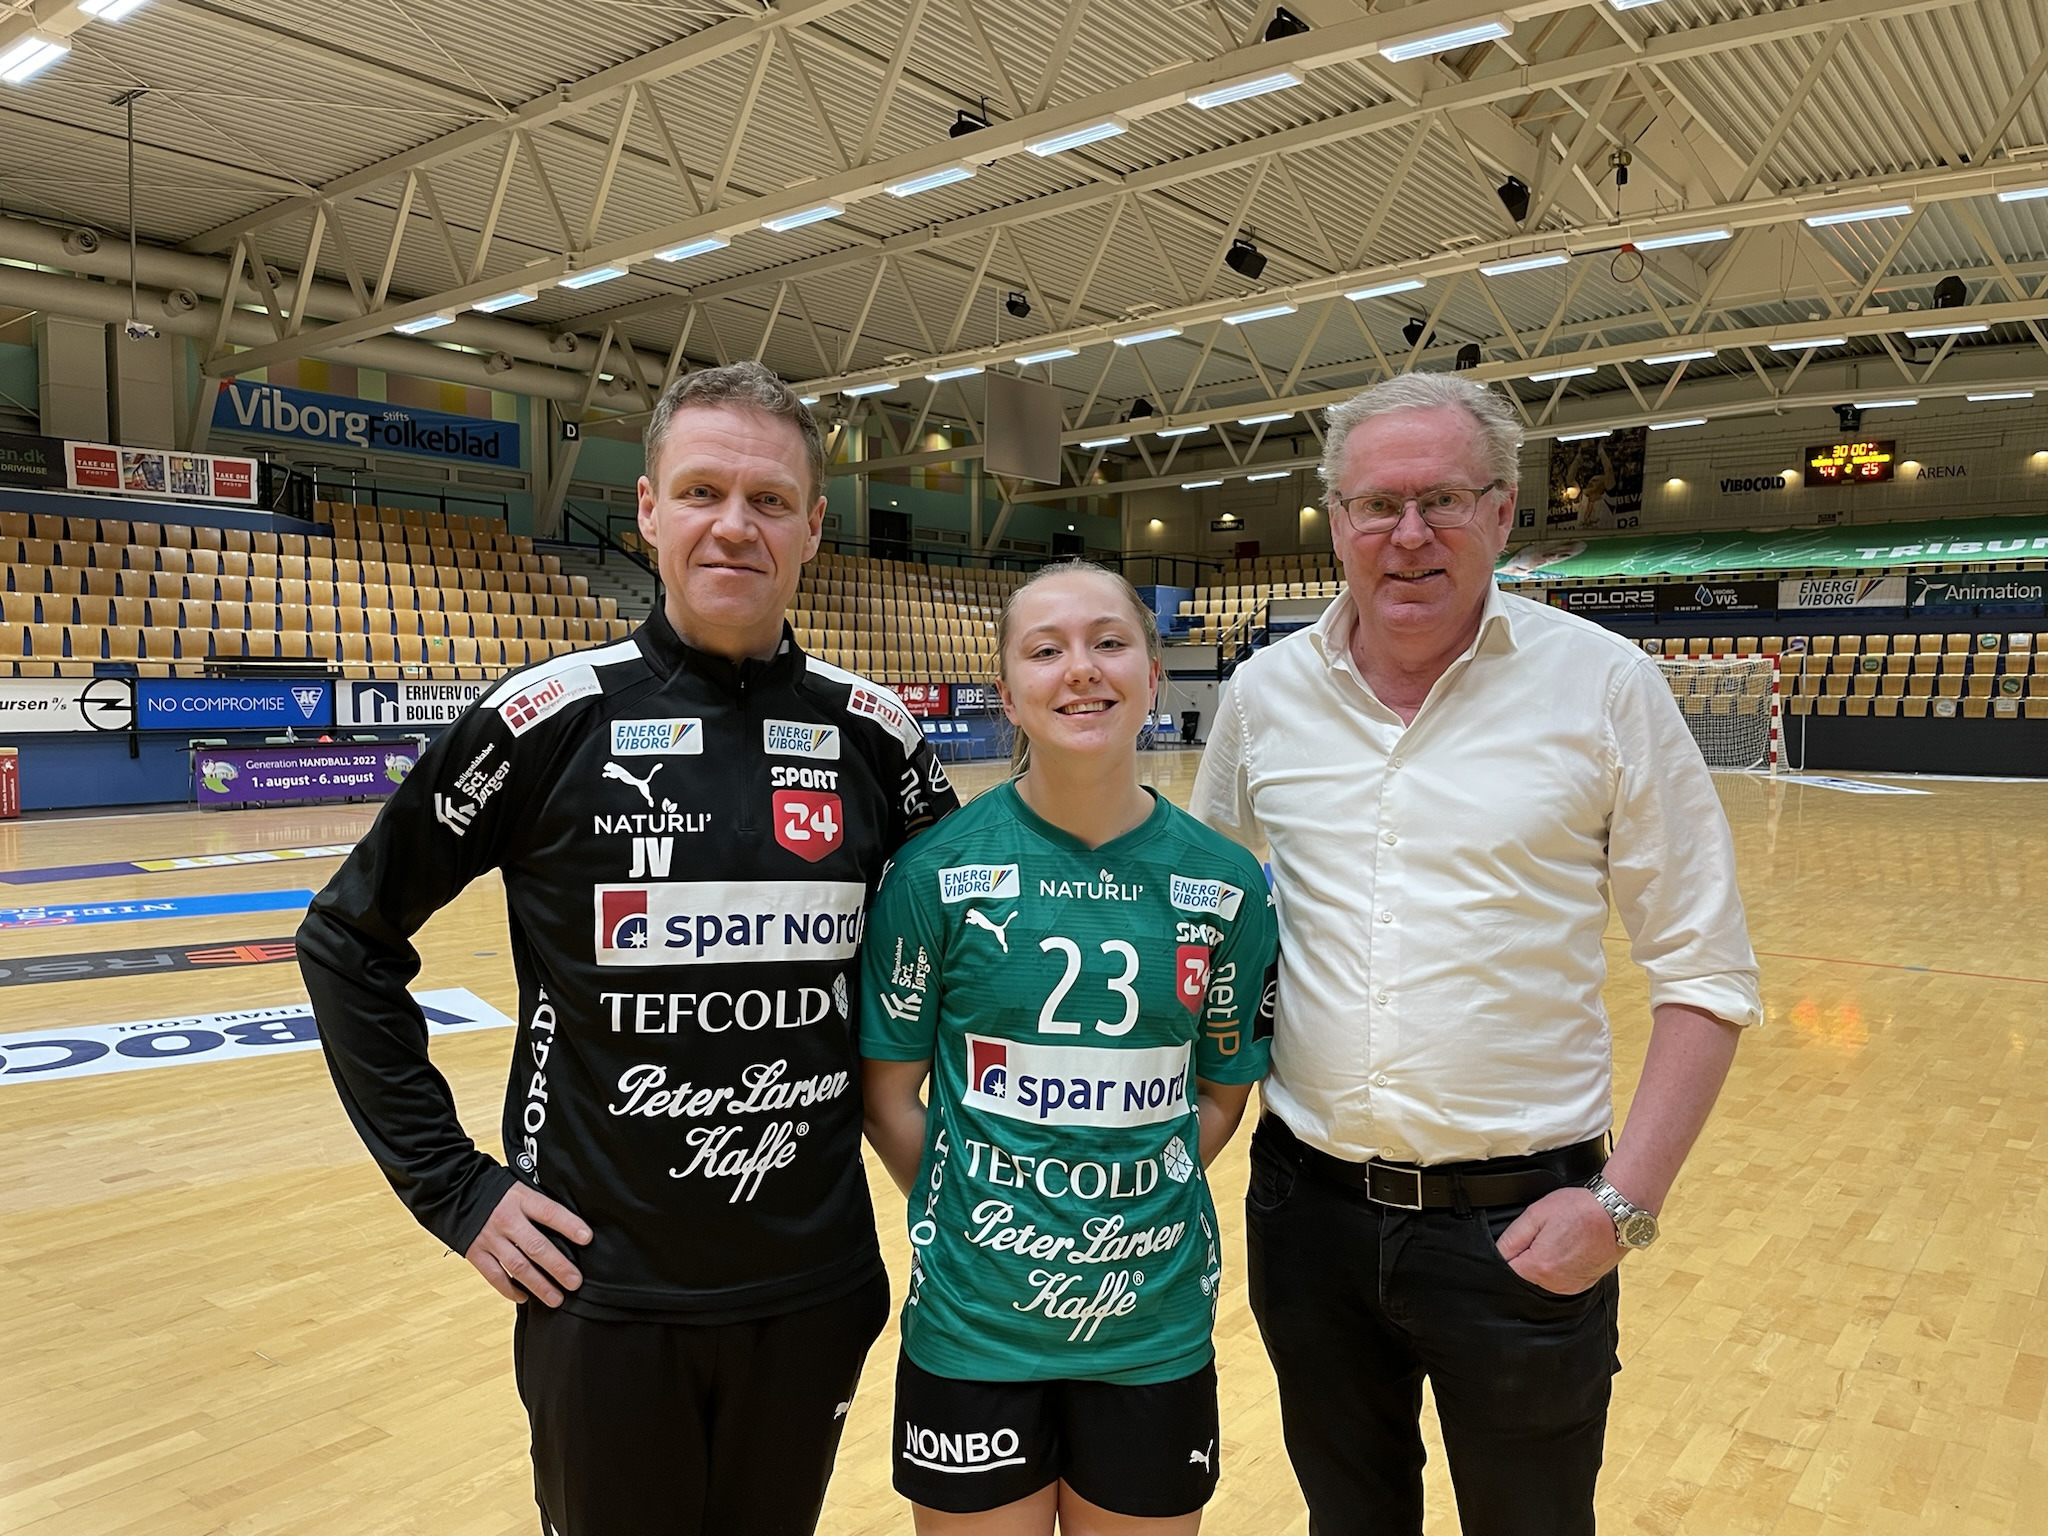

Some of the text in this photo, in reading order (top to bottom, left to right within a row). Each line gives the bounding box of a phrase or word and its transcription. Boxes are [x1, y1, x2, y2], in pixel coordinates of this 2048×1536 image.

[228, 385, 500, 458] Viborg Folkeblad
[383, 411, 409, 423] Stifts
[567, 424, 576, 437] D
[1, 463, 48, 475] DRIVHUSE
[76, 459, 115, 469] TAKE ONE
[1819, 466, 1836, 477] 44
[1861, 463, 1879, 475] 25
[235, 473, 249, 481] ONE
[1916, 465, 1966, 480] ARENA
[1720, 476, 1786, 493] VIBOCOLD
[1524, 514, 1533, 526] F
[1800, 580, 1858, 594] ENERGI
[1944, 582, 2042, 600] Animation
[1569, 590, 1655, 605] COLORS
[1716, 594, 1738, 605] VVS
[1798, 593, 1856, 606] VIBORG
[300, 690, 317, 704] AC
[406, 686, 480, 700] ERHVERV OG
[532, 679, 565, 708] mli
[148, 696, 285, 712] NO COMPROMISE
[407, 706, 443, 720] BOLIG
[877, 704, 904, 727] mli
[617, 724, 671, 738] ENERGI
[769, 725, 813, 740] ENERGI
[616, 737, 670, 750] VIBORG
[768, 737, 812, 751] VIBORG
[246, 755, 377, 769] Generation HANDBALL 2022
[252, 776, 263, 788] 1.
[266, 775, 310, 789] august
[319, 775, 330, 785] 6.
[333, 772, 374, 786] august
[771, 766, 838, 790] SPORT
[783, 802, 839, 842] 24
[629, 837, 674, 878] JV
[945, 869, 991, 885] ENERGI
[944, 881, 990, 897] VIBORG
[1173, 880, 1221, 897] ENERGI
[1173, 891, 1218, 908] VIBORG
[664, 914, 776, 958] spar
[1038, 936, 1139, 1036] 23
[600, 987, 831, 1033] TEFCOLD
[1206, 962, 1241, 1056] netIP
[108, 1008, 310, 1032] THAN COOL
[608, 1059, 849, 1118] Peter Larsen
[1017, 1075, 1117, 1119] spar
[965, 1139, 1158, 1199] TEFCOLD
[964, 1199, 1186, 1265] Peter Larsen
[906, 1421, 1019, 1464] NONBO
